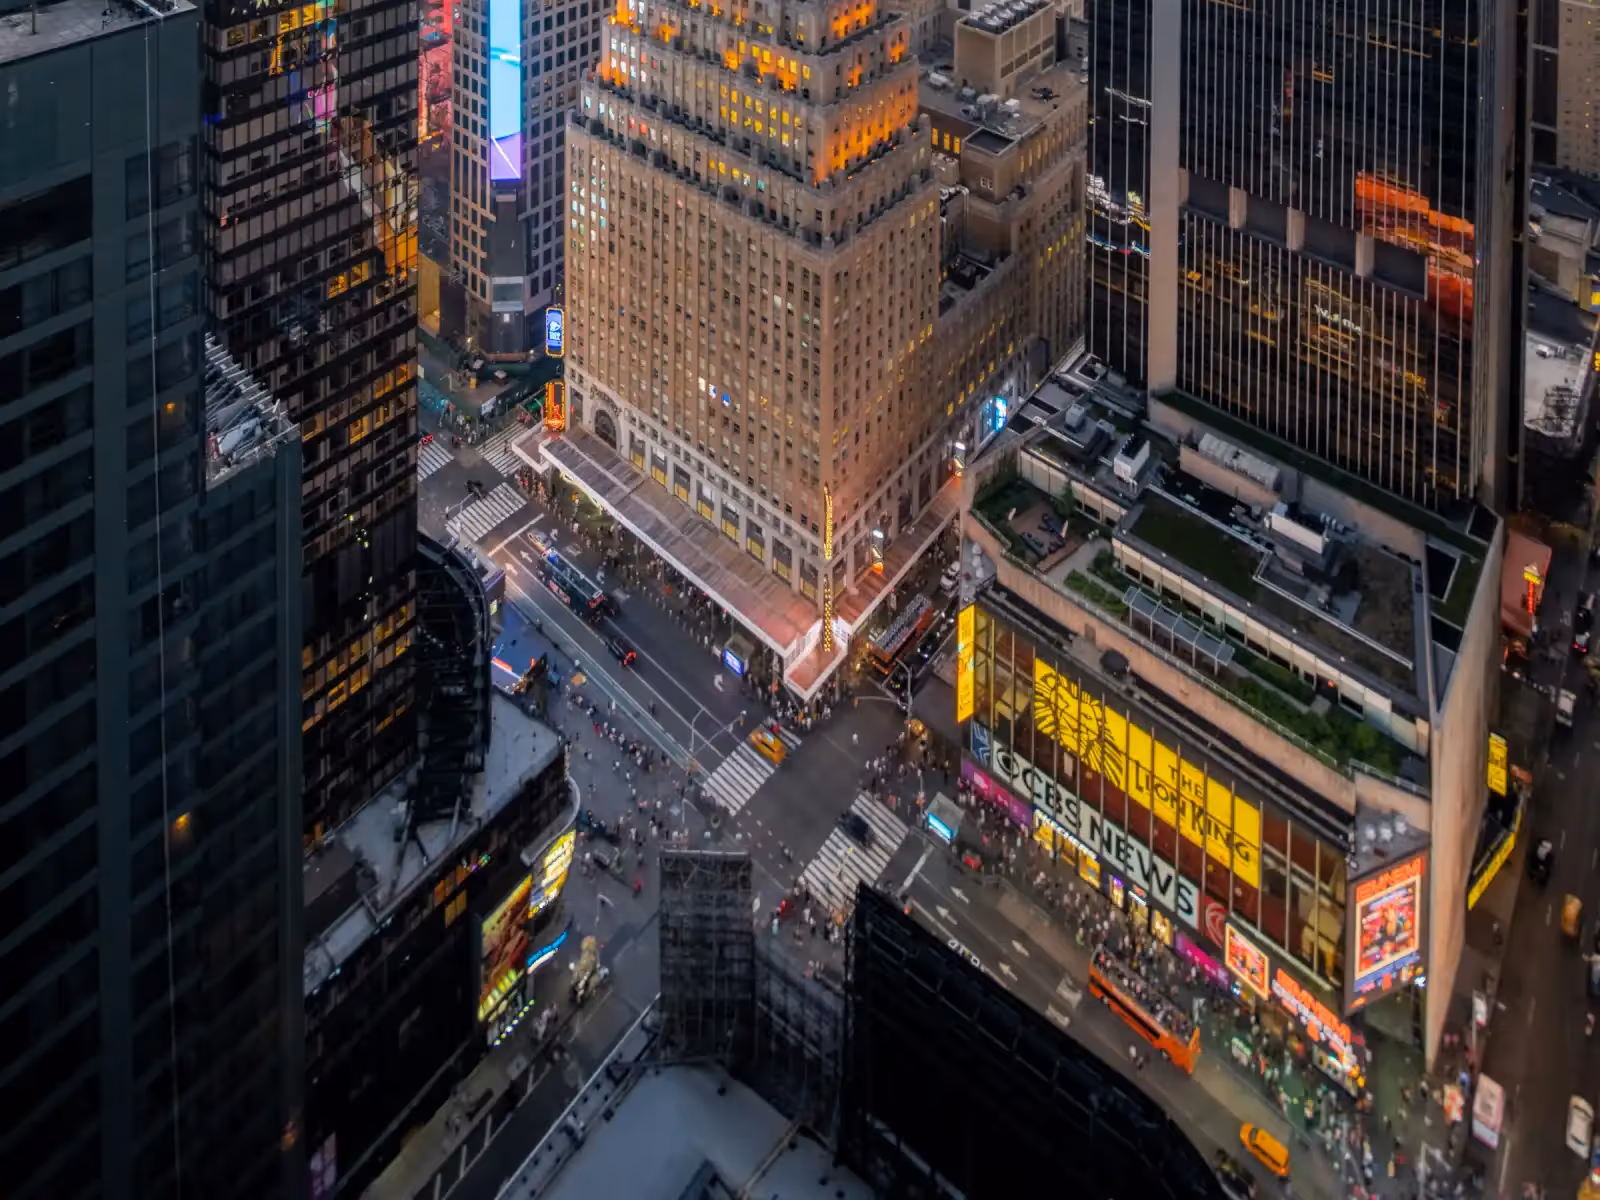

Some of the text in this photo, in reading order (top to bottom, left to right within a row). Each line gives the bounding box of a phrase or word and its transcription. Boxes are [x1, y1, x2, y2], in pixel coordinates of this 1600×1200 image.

[1134, 759, 1250, 862] LION KING
[1168, 763, 1204, 800] THE
[1022, 767, 1081, 829] CBS
[1090, 814, 1194, 916] NEWS
